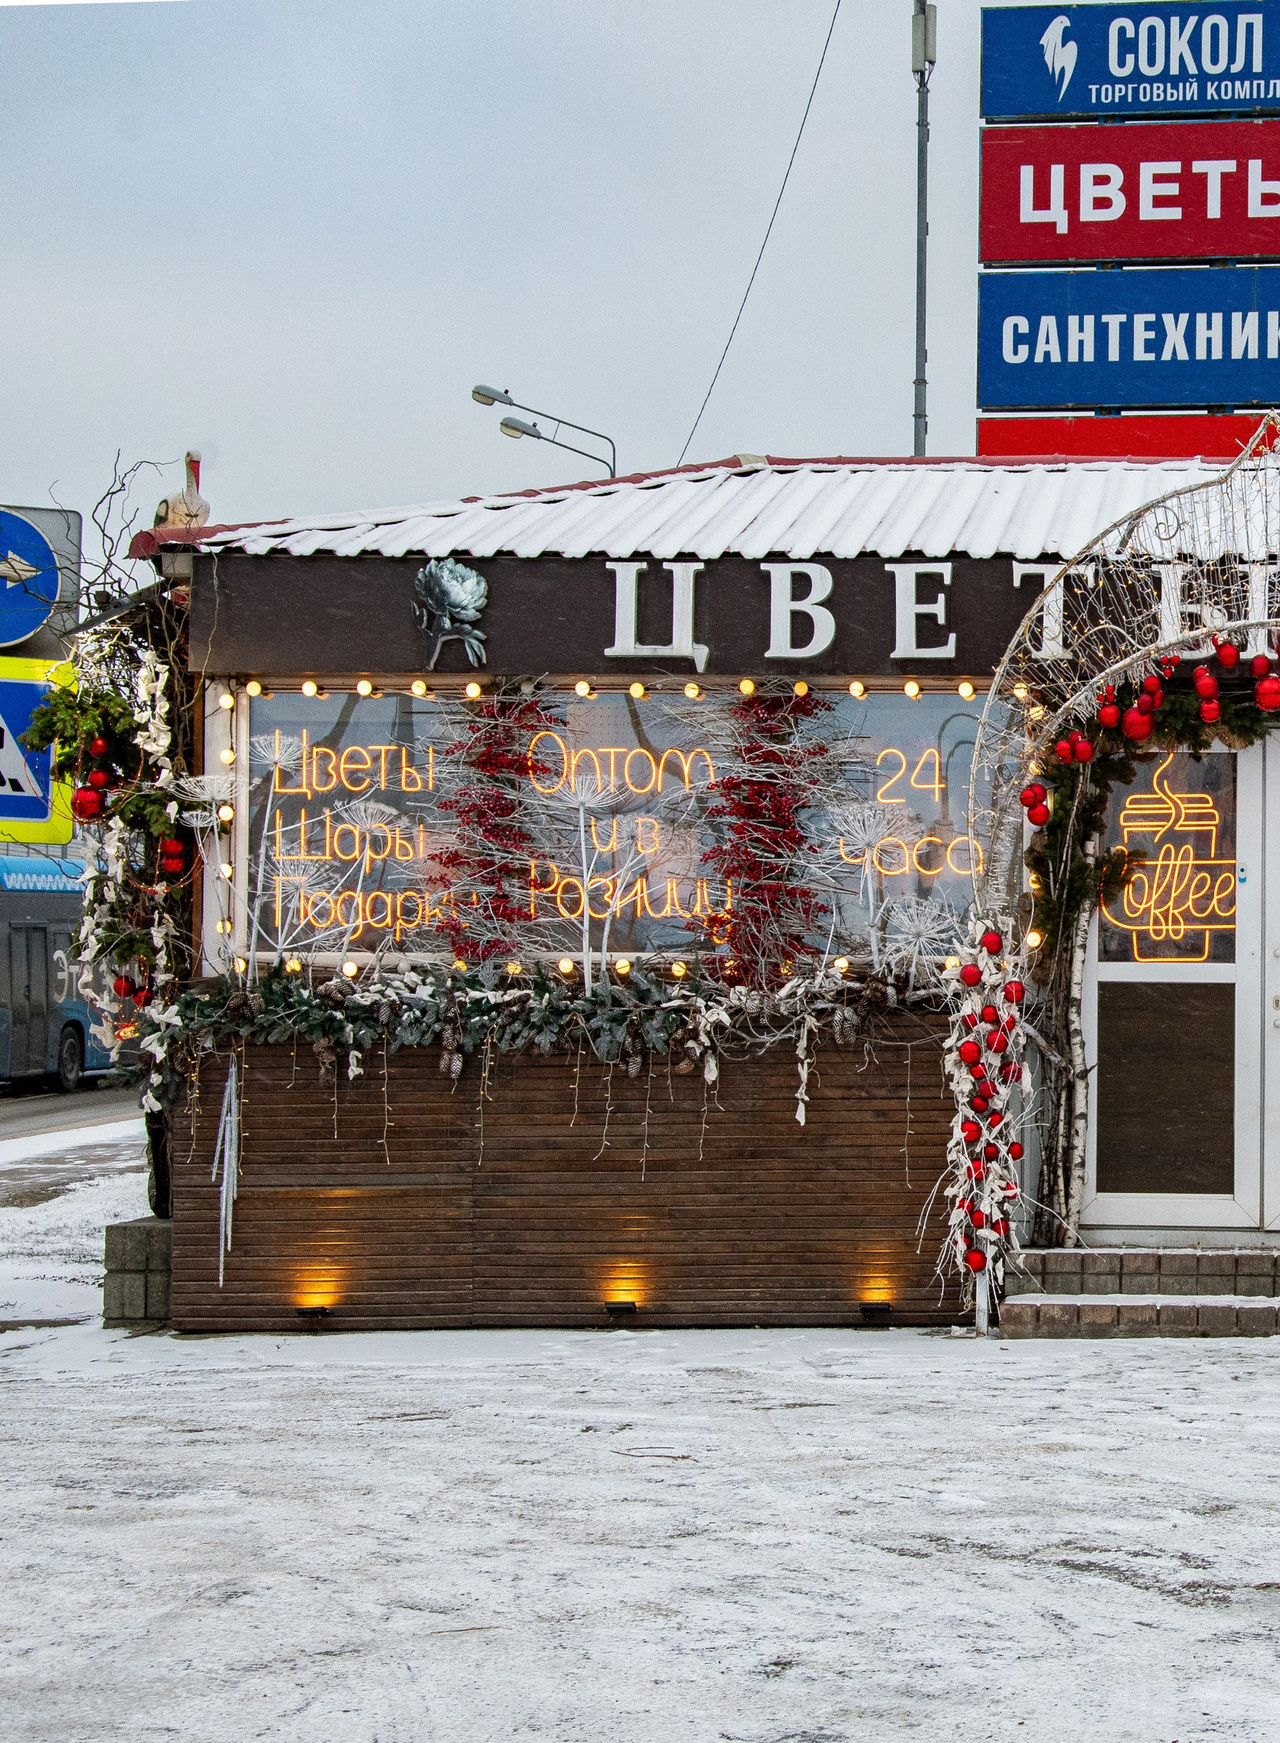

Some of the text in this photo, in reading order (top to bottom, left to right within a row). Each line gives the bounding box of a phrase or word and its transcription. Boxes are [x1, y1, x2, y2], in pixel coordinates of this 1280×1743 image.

[1107, 12, 1264, 78] СОКОЛ
[1088, 78, 1199, 104] ТОРГОВЫЙ
[604, 560, 1280, 673] ЦВЕТЫ
[273, 728, 435, 801] Цветы
[527, 730, 716, 794] Оптом
[875, 747, 947, 803] 24
[273, 808, 425, 874] Шары
[838, 835, 986, 876] часа
